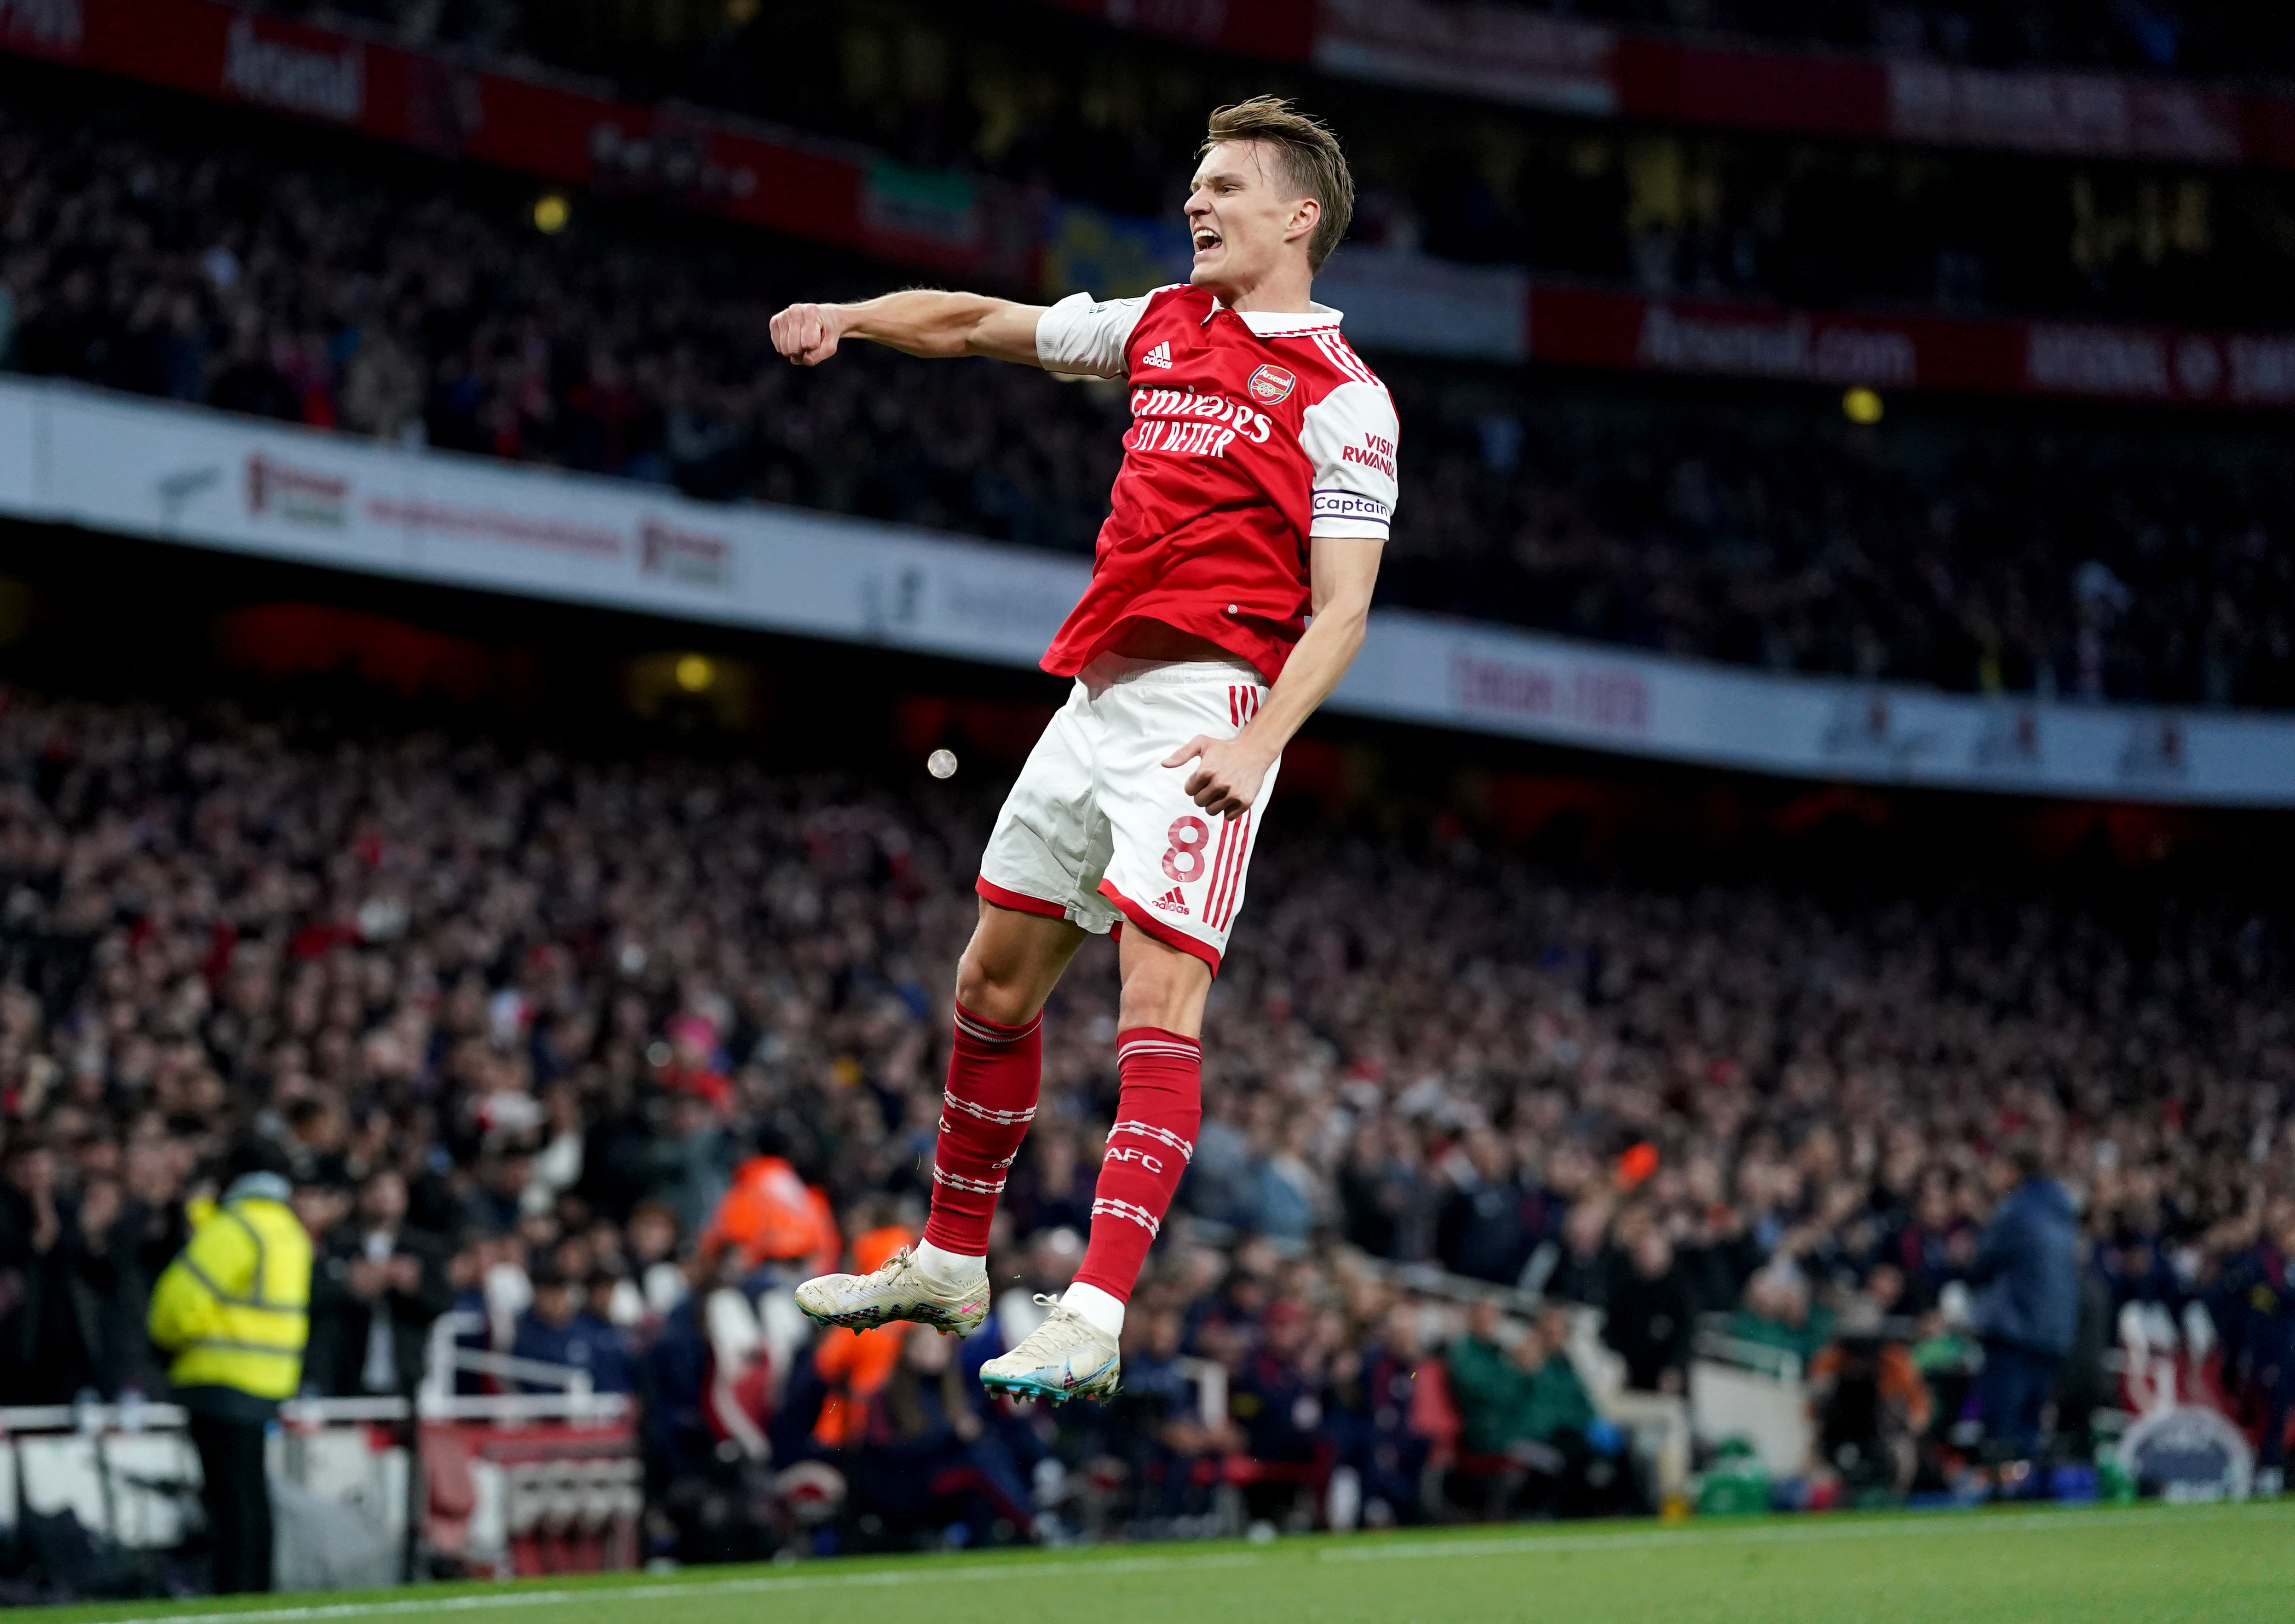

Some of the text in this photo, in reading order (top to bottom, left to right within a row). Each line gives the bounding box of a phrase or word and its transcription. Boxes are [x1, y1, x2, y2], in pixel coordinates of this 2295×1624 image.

[1142, 355, 1173, 369] adidas
[1260, 370, 1290, 387] Arsenal
[1131, 384, 1272, 443] Emirates
[1130, 421, 1236, 458] FLY BETTER
[1365, 432, 1393, 458] VISIT
[1342, 445, 1395, 482] RWANDA
[1315, 497, 1388, 516] Captain
[1162, 815, 1209, 883] 8
[1152, 899, 1190, 915] adidas
[1104, 1148, 1163, 1173] AFC
